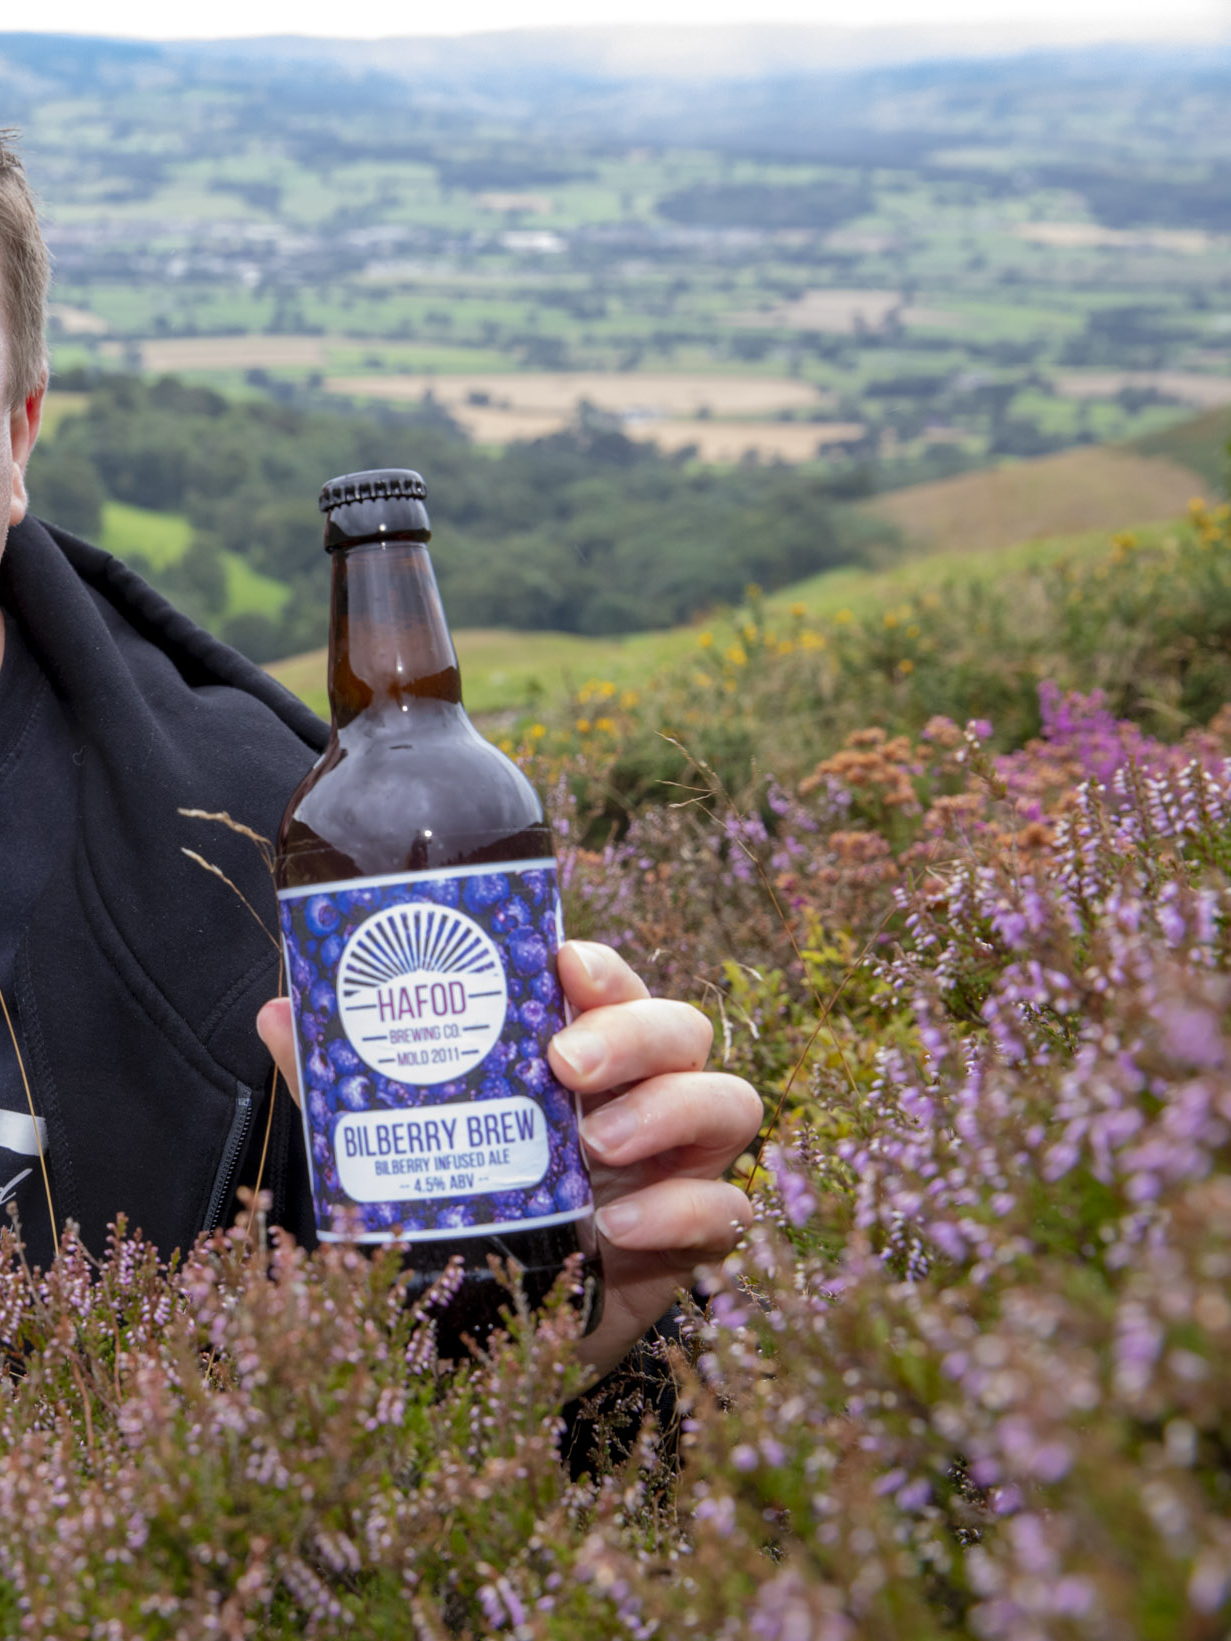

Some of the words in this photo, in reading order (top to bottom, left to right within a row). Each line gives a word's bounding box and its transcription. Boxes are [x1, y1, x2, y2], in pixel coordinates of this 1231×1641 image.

[377, 981, 467, 1023] HAFOD
[389, 1025, 441, 1044] BREWING
[443, 1024, 462, 1039] CO.
[397, 1051, 430, 1067] MOLD
[431, 1047, 460, 1064] 2011
[343, 1117, 457, 1158] BILBERRY
[467, 1108, 535, 1148] BREW
[374, 1157, 430, 1176] BILBERRY
[434, 1152, 485, 1172] INFUSED
[488, 1148, 511, 1165] ALE
[413, 1176, 446, 1193] 4.5%
[450, 1173, 474, 1190] ABV
